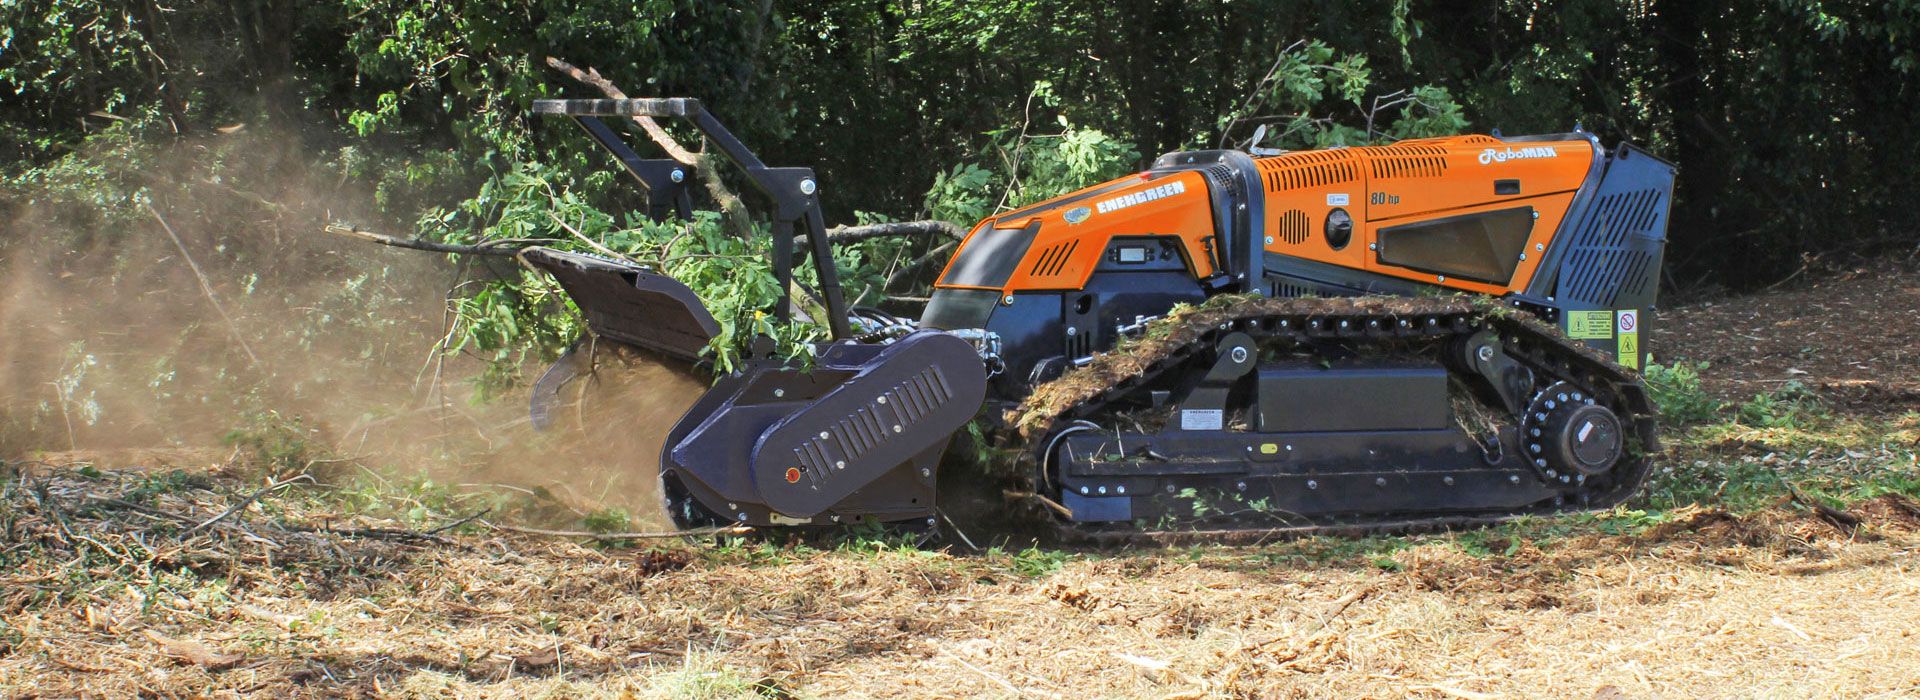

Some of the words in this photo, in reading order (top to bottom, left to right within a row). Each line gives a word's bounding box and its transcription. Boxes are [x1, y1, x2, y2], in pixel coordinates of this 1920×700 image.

[1478, 146, 1557, 165] RoboMAX
[1096, 181, 1185, 214] ENERGREEN
[1371, 192, 1386, 205] 80
[1388, 194, 1400, 205] hp
